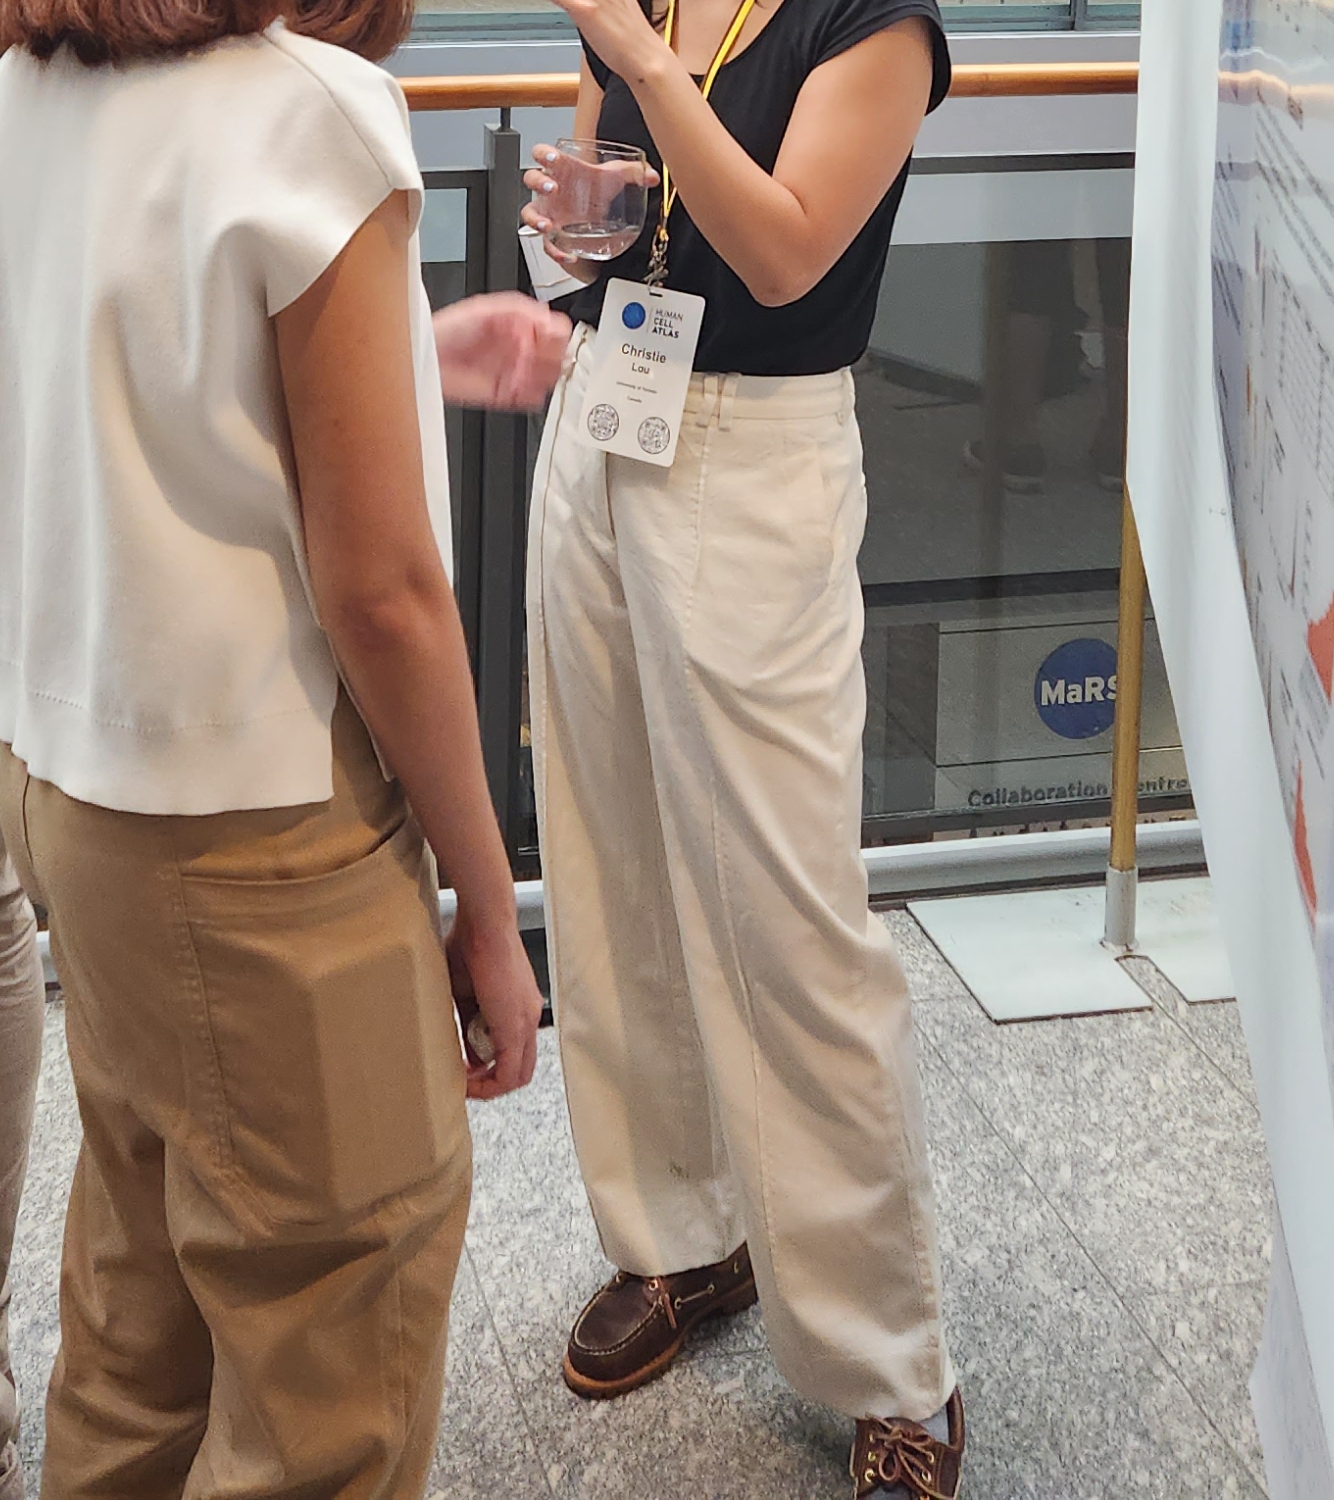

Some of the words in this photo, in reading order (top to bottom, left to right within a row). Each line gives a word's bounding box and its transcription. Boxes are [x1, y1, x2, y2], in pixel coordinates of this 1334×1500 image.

[653, 317, 673, 329] CELL
[655, 308, 684, 322] HUMAN
[652, 327, 680, 339] ATLAS
[621, 343, 667, 364] Christie
[1040, 675, 1118, 707] MaRS
[967, 780, 1109, 808] Collaboration
